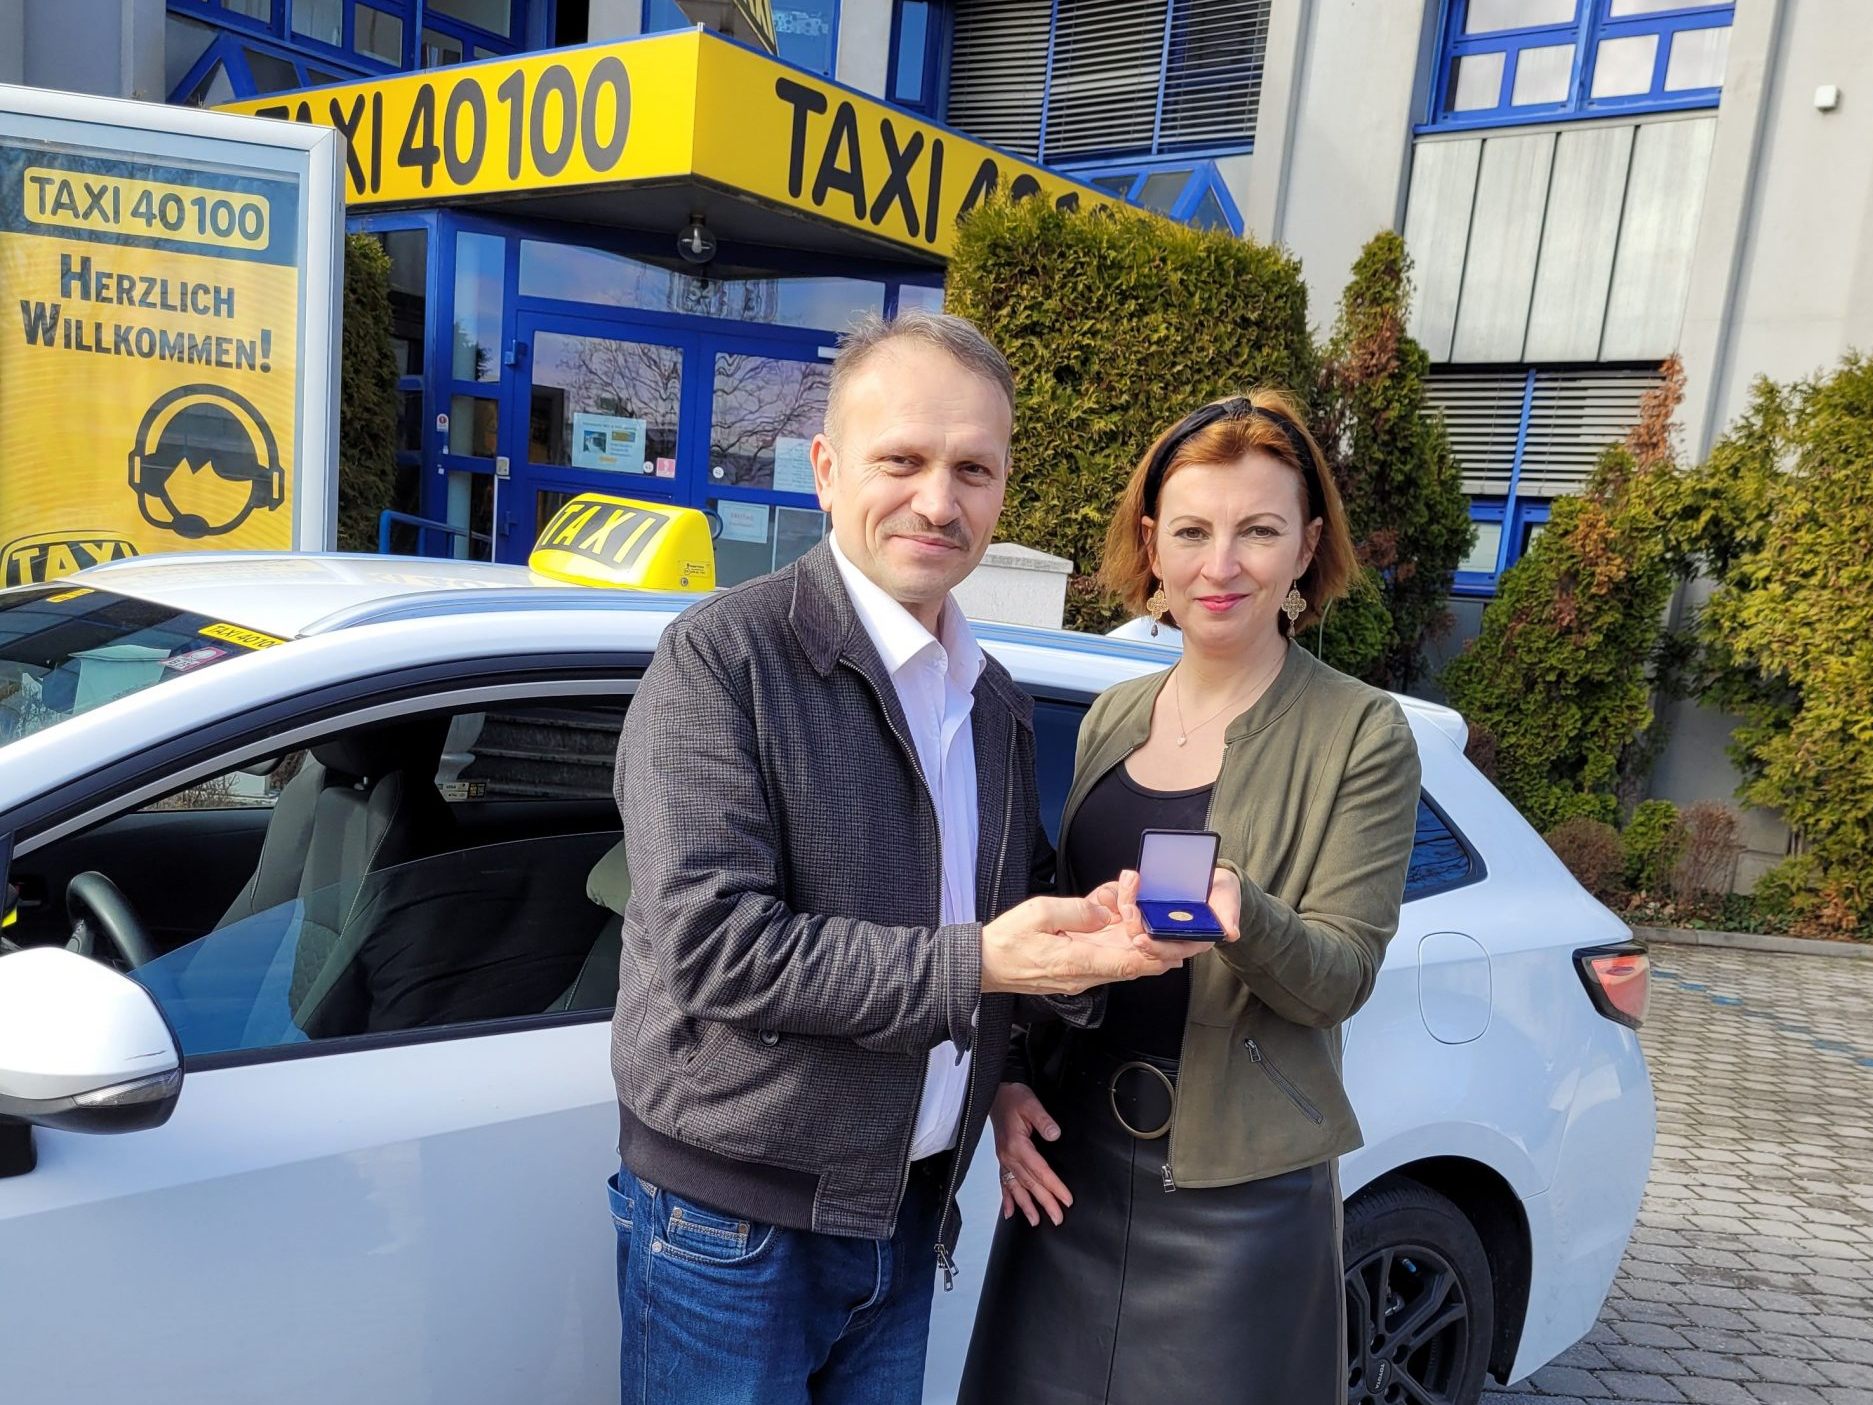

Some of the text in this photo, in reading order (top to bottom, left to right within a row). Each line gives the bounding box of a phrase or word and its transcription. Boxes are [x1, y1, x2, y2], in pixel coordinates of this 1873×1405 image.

[775, 77, 944, 243] TAXI
[29, 175, 120, 225] TAXI
[541, 504, 656, 563] TAXI
